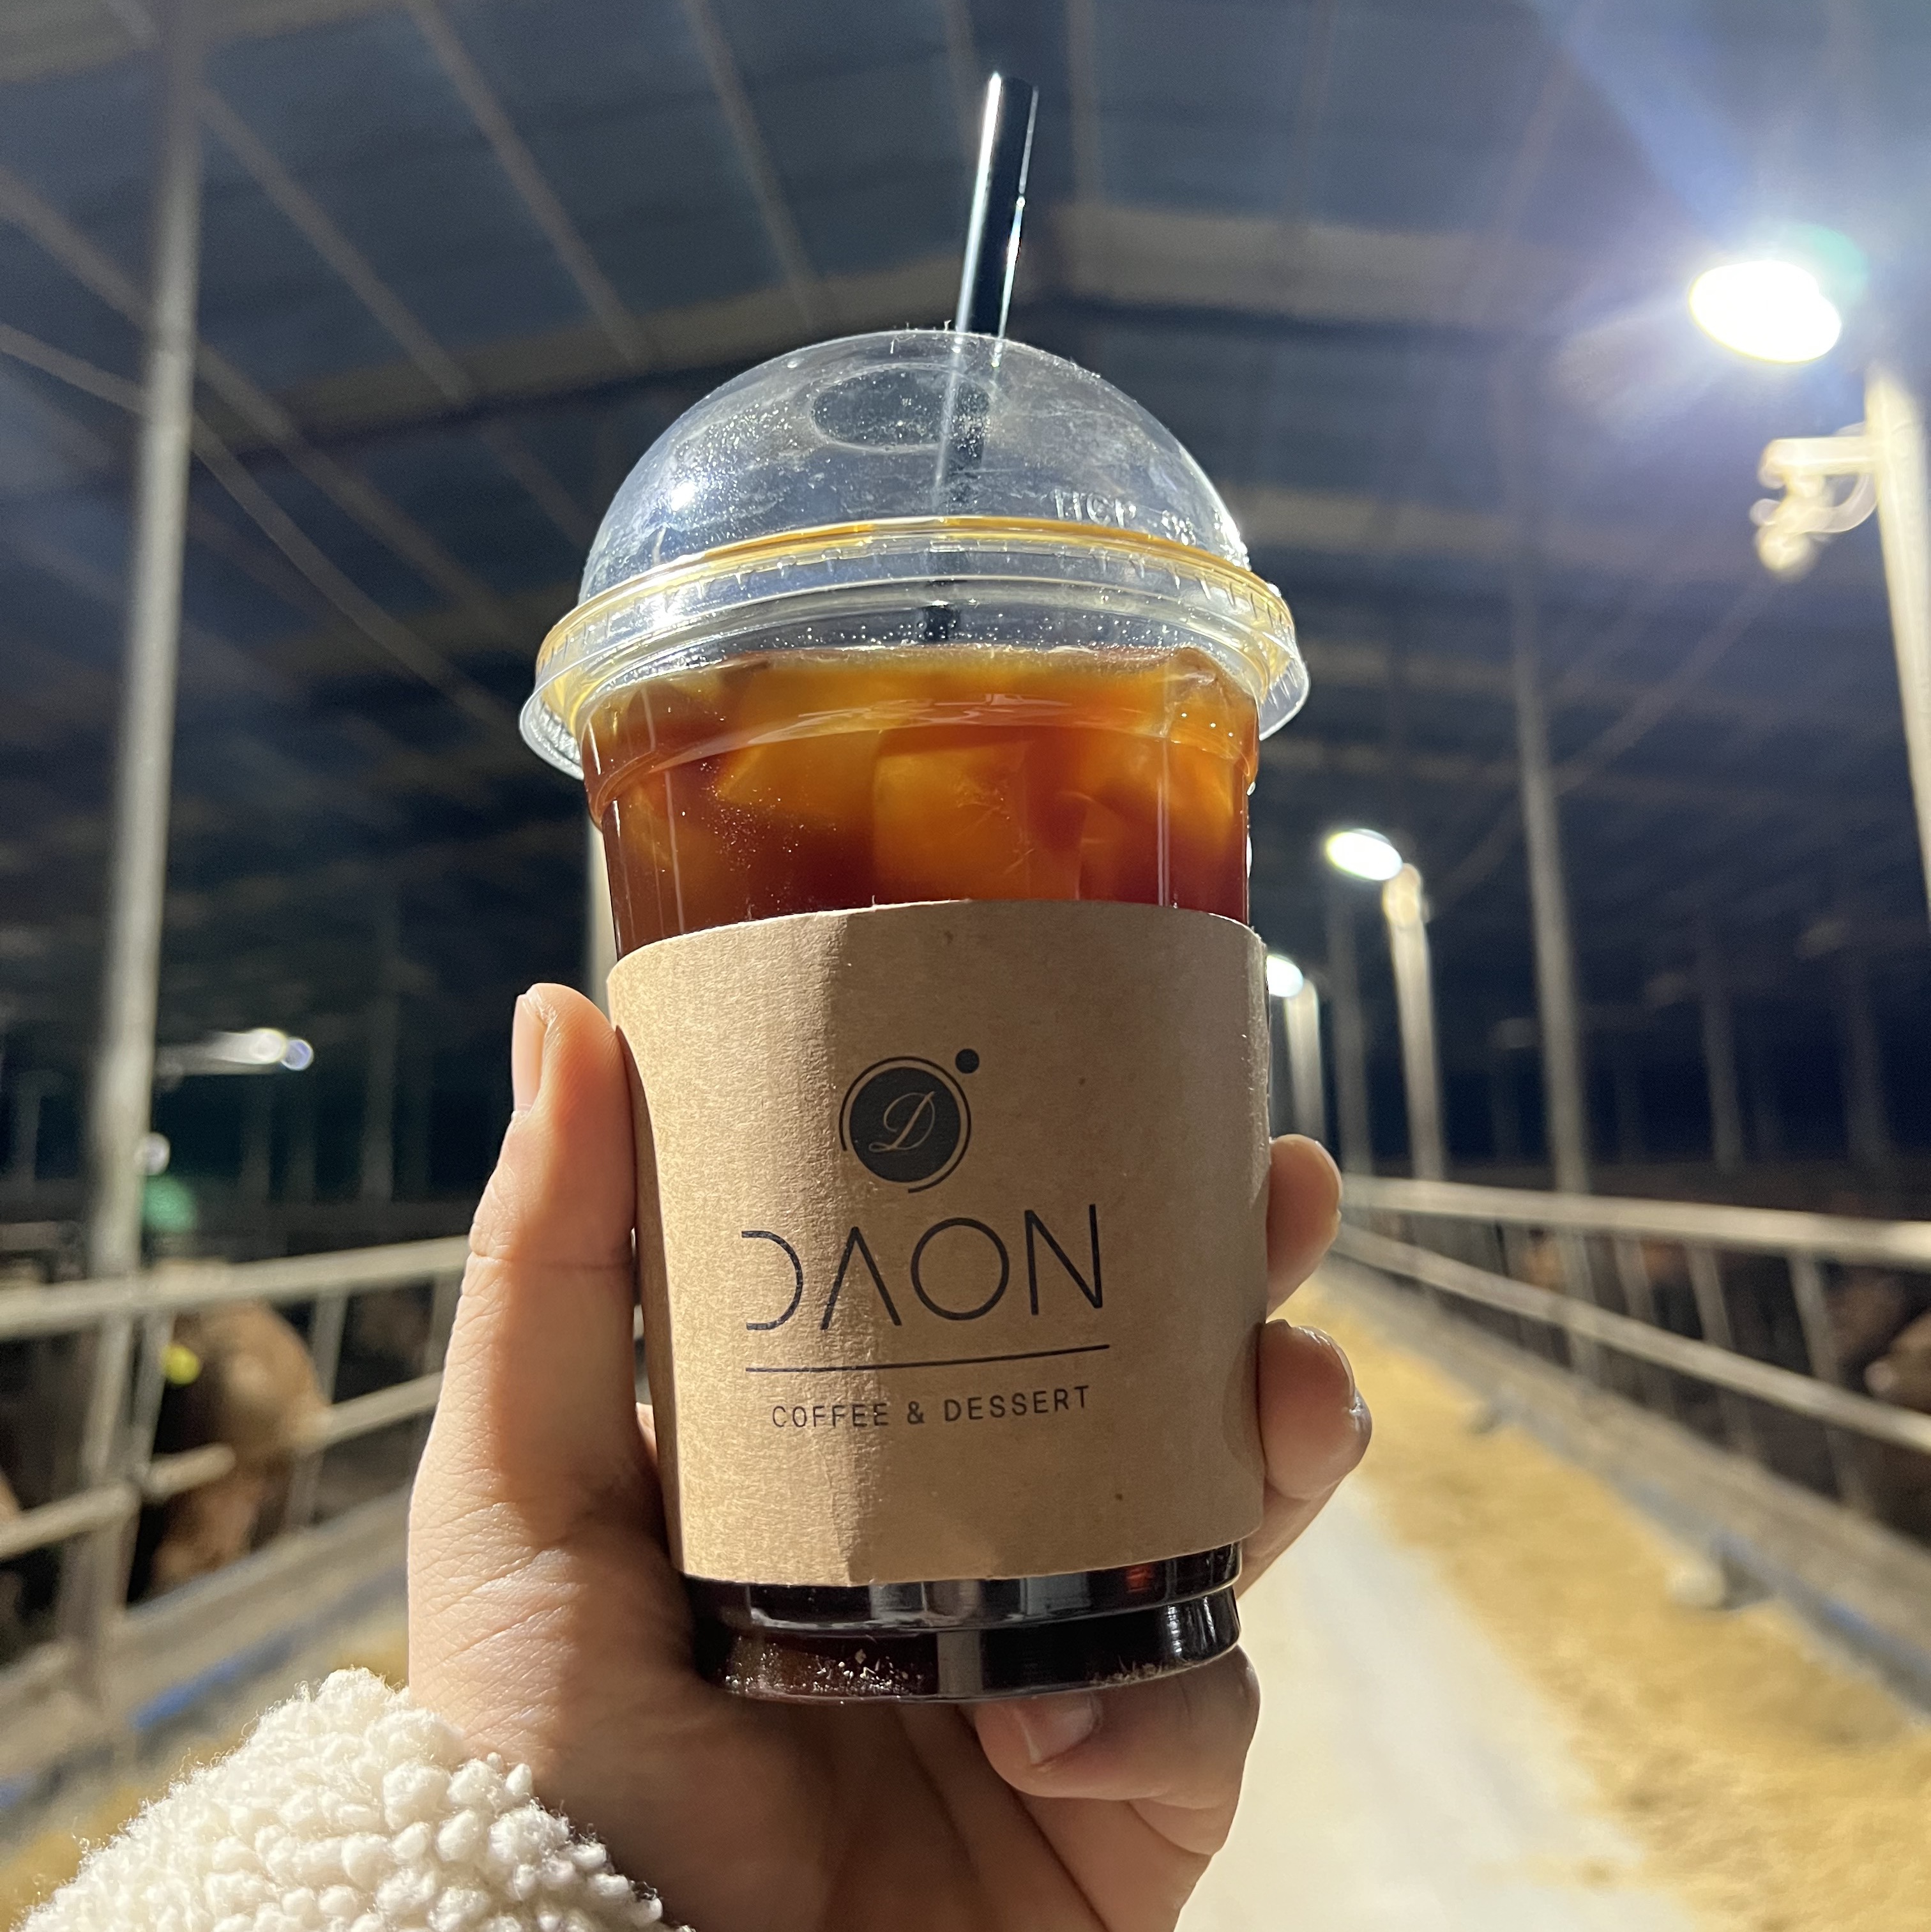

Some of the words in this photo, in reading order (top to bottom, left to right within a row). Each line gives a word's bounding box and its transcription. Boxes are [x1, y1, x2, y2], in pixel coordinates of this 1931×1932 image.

[868, 1090, 936, 1153] D
[741, 1203, 1103, 1330] DAON
[772, 1403, 890, 1428] COFFEE
[907, 1401, 925, 1424] &
[944, 1385, 1090, 1422] DESSERT
